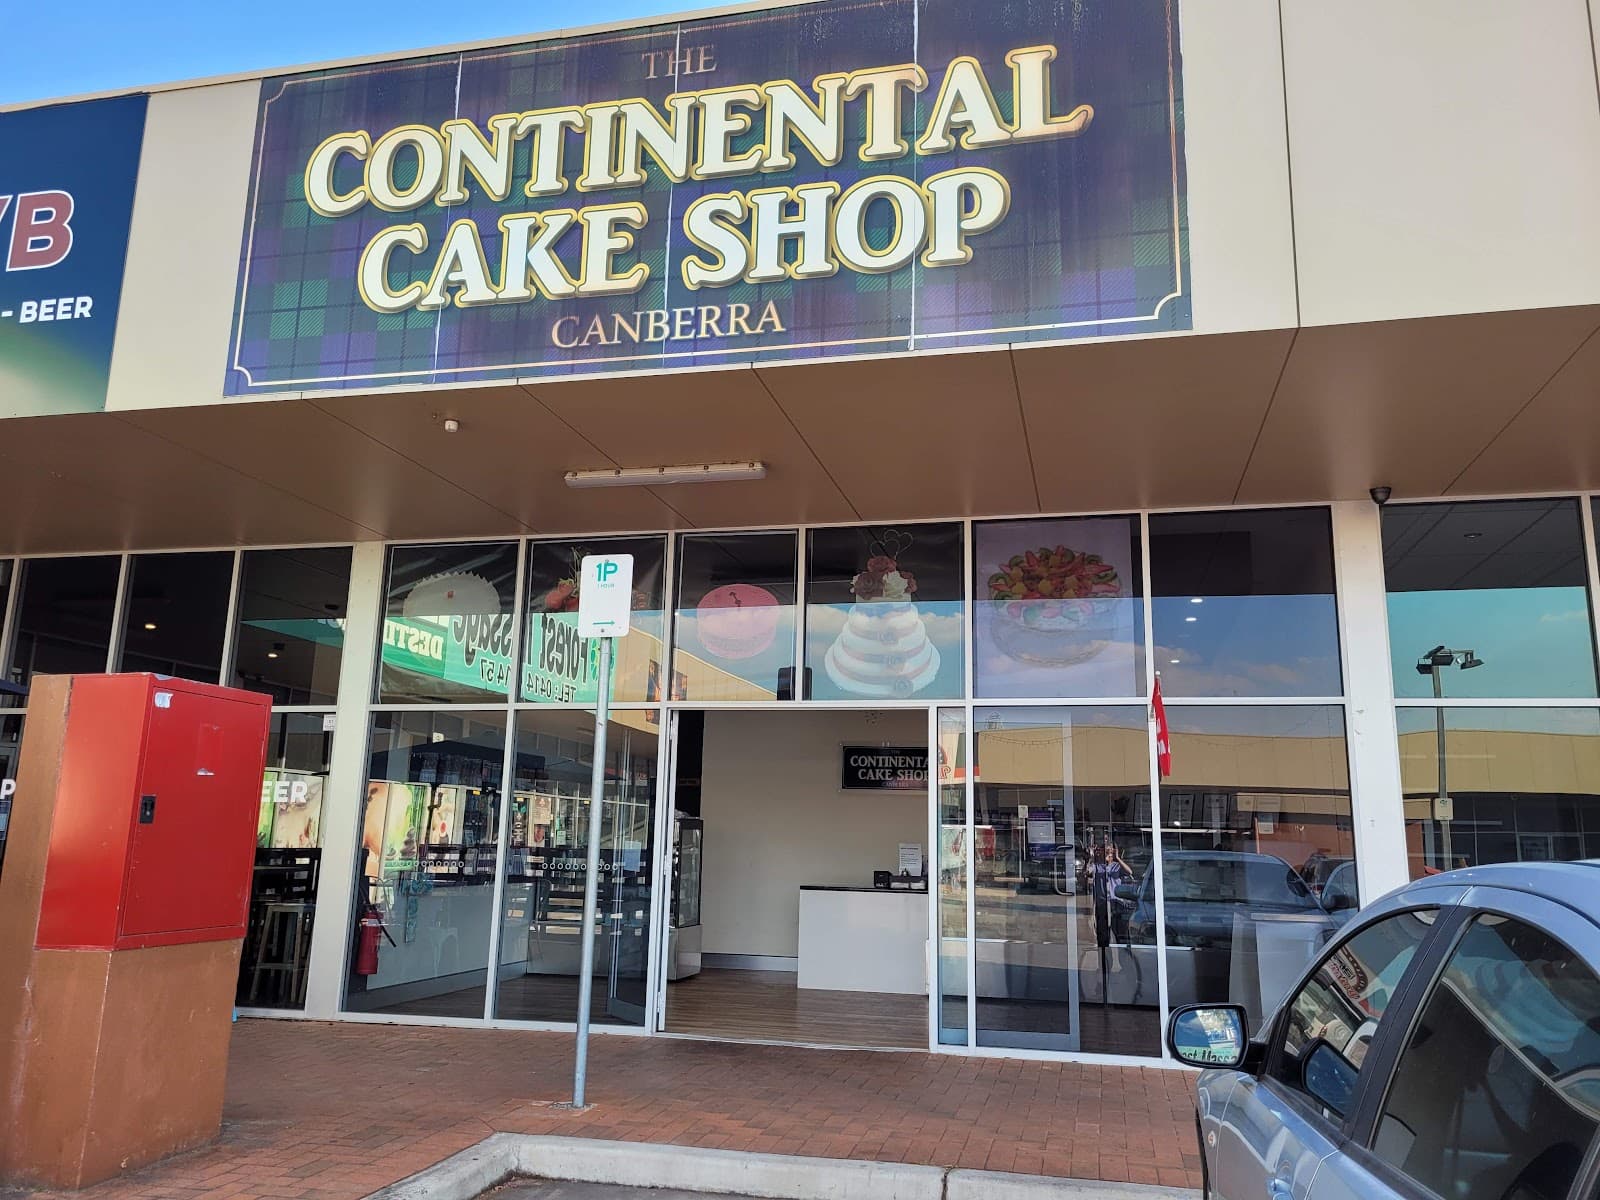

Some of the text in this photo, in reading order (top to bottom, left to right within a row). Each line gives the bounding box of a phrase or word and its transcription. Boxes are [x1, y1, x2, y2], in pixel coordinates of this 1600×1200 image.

[642, 44, 718, 79] THE
[304, 44, 1094, 218] CONTINENTAL
[359, 167, 1011, 314] CAKE SHOP
[19, 296, 93, 323] BEER
[551, 300, 786, 350] CANBERRA
[596, 562, 618, 582] 1P
[850, 755, 928, 768] CONTINENTA
[858, 768, 893, 781] CAKE
[261, 780, 308, 803] EER
